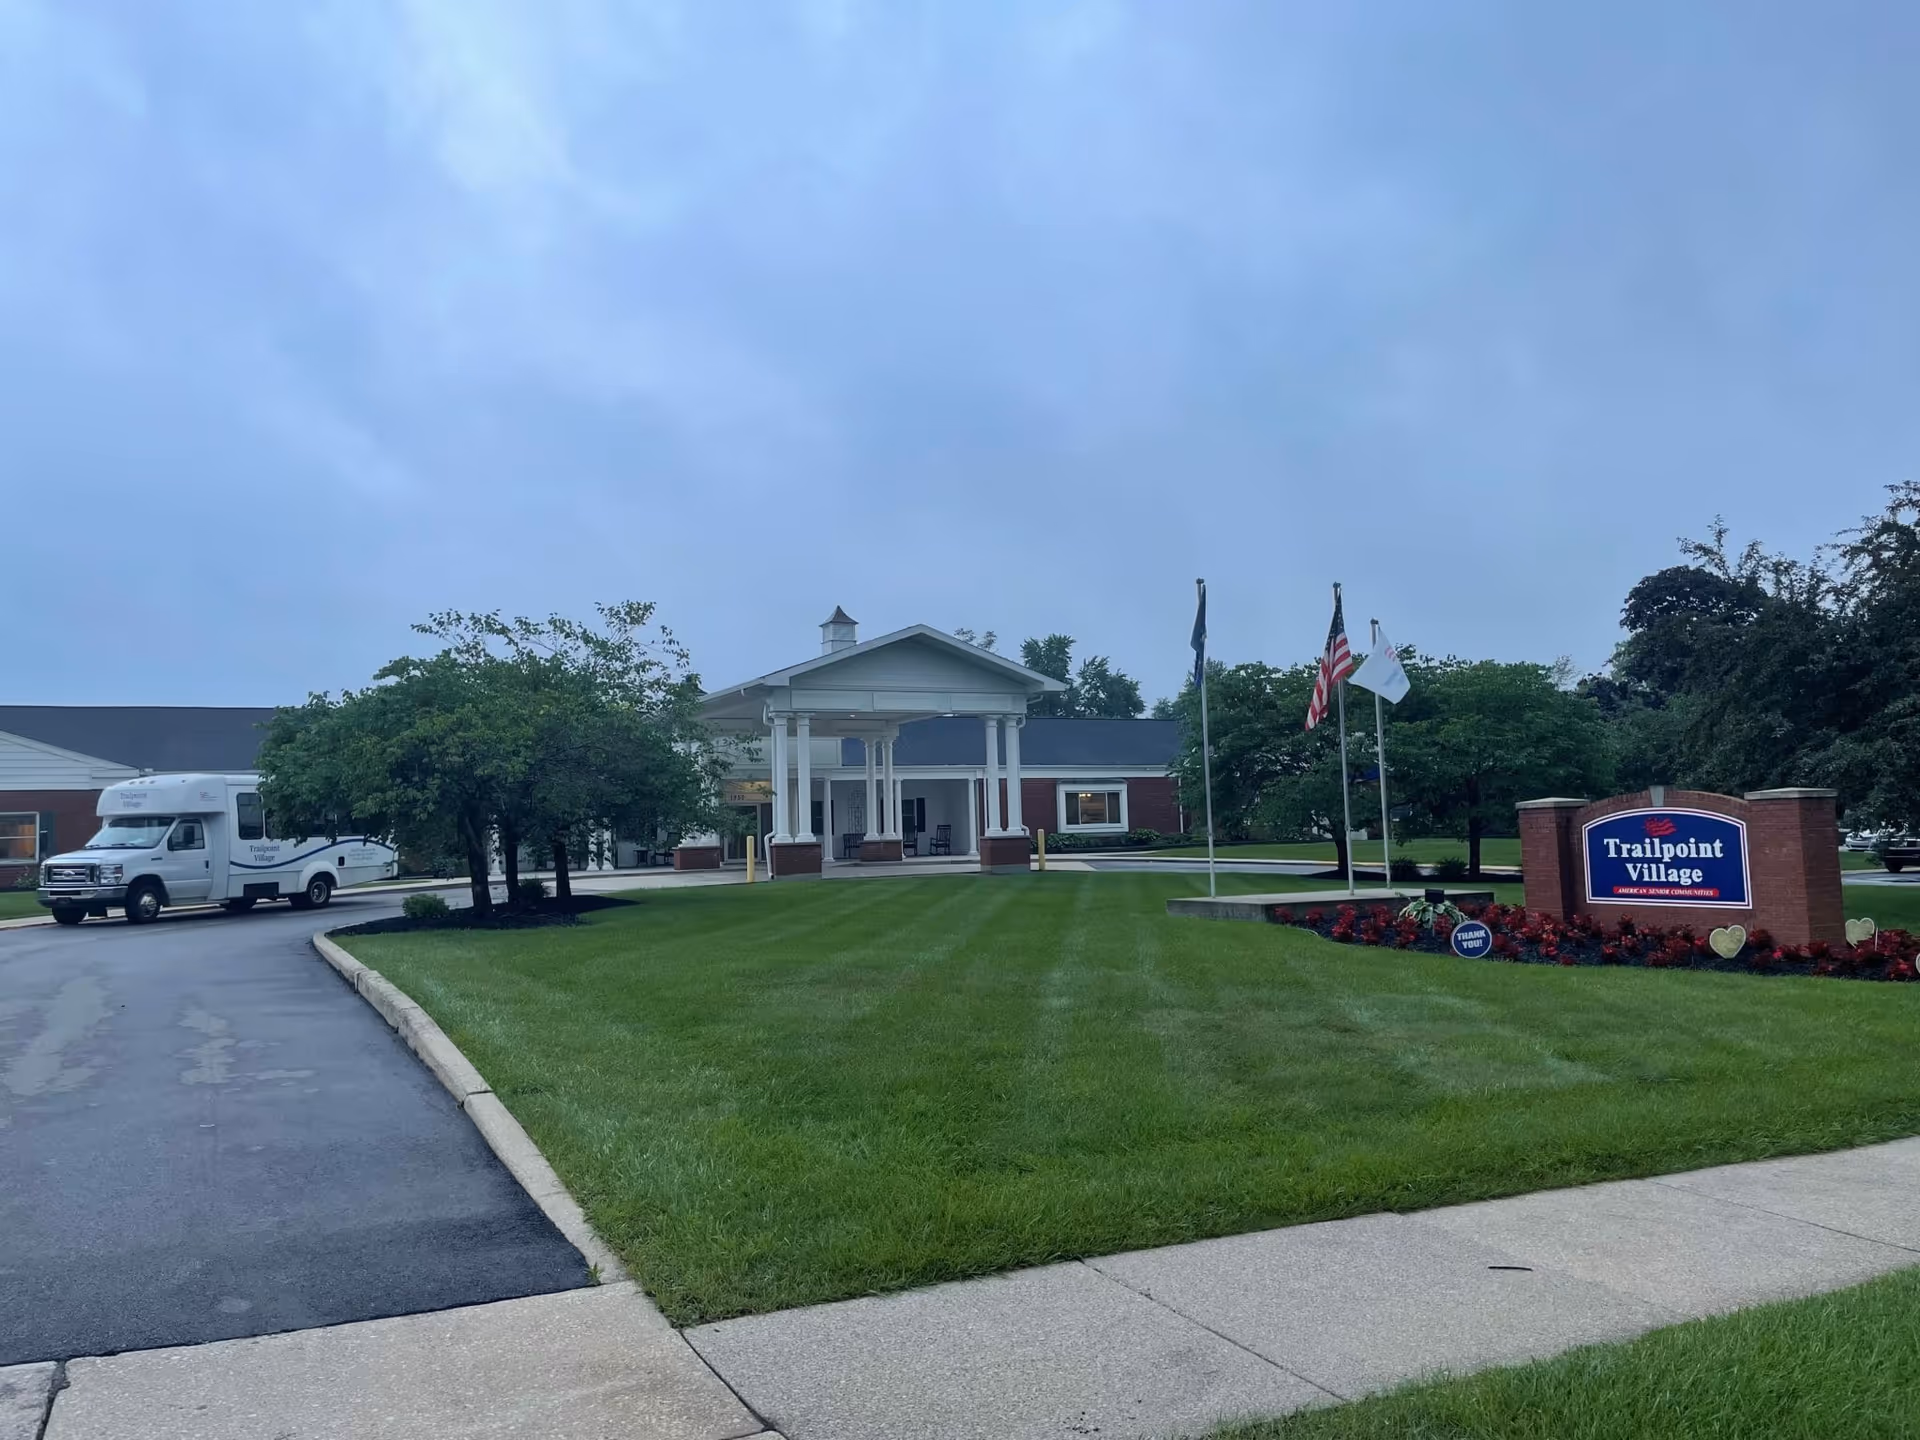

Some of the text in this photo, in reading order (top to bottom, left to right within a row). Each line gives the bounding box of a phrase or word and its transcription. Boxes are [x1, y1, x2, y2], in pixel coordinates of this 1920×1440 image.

[1604, 838, 1723, 862] Trailpoint
[1625, 863, 1703, 886] Village
[1671, 889, 1714, 897] COMMUNITIES
[1456, 930, 1486, 940] THANK
[1462, 939, 1483, 949] YOU!
